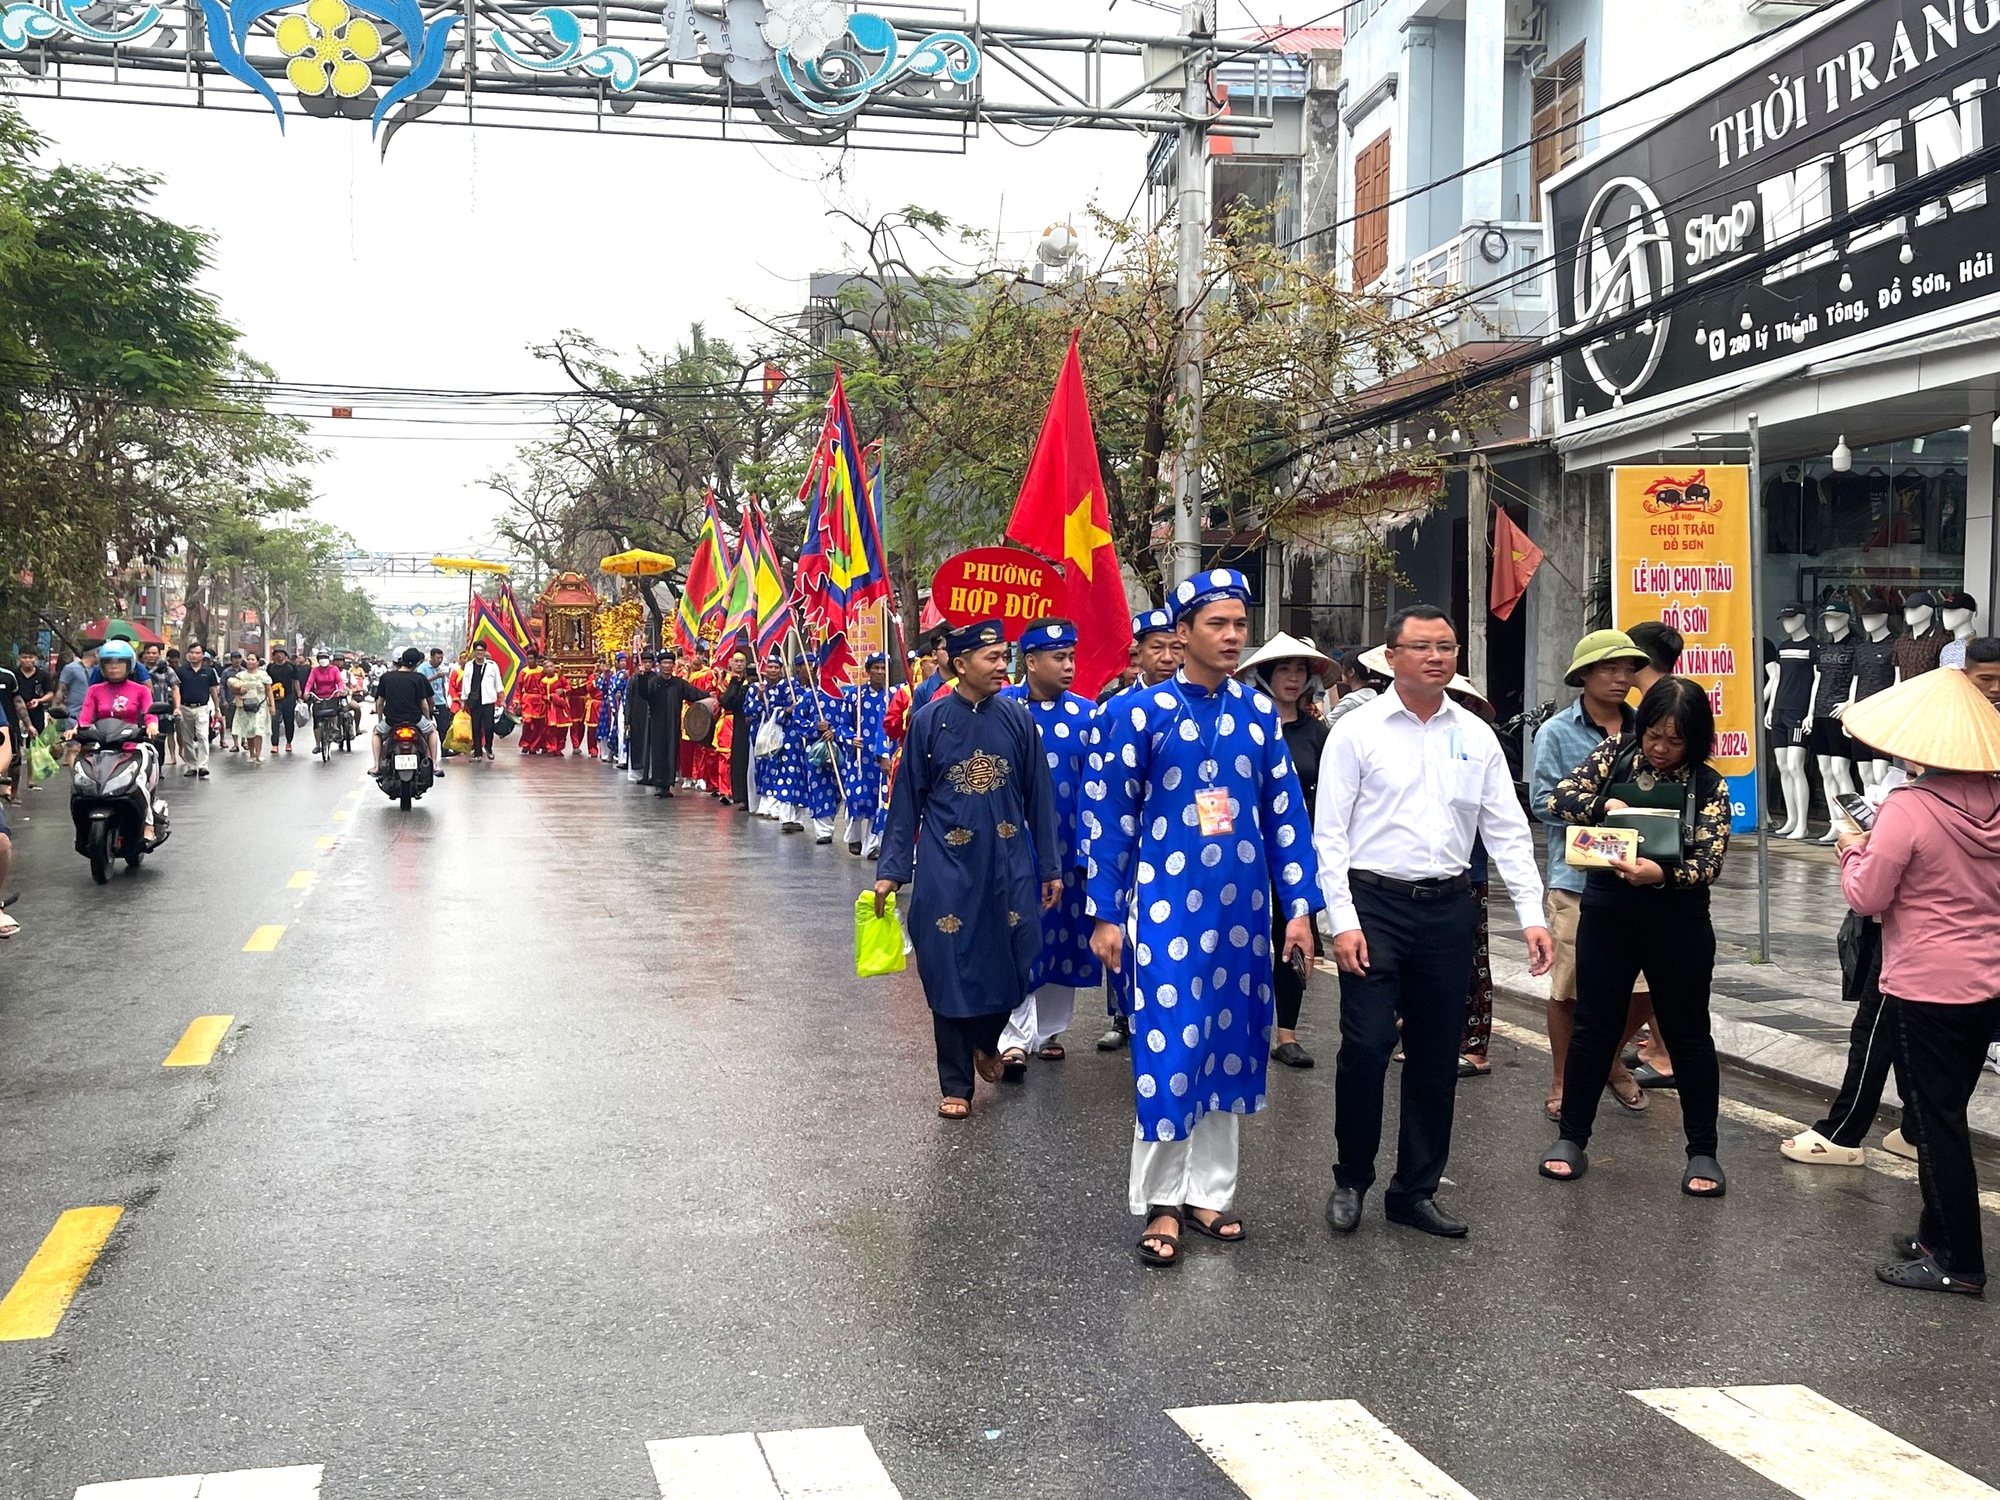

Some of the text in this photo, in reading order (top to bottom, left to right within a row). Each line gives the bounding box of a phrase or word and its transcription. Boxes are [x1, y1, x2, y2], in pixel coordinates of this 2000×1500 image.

[1709, 0, 2000, 169] THỜI TRANG
[1685, 200, 1756, 266] Shop
[1729, 334, 1751, 357] 280
[1755, 324, 1769, 350] Lý
[1825, 300, 1869, 326] Tông,
[1878, 277, 1902, 310] Đồ
[1911, 272, 1951, 297] Sơn,
[1959, 252, 1994, 284] Hải
[1650, 521, 1715, 538] CHỌI TRÂU
[1682, 539, 1704, 550] SƠN
[962, 561, 1043, 588] PHƯỜNG
[1633, 559, 1732, 597] LỄ HỘI CHỌI TRÂU
[949, 586, 1053, 620] HỢP ĐỨC
[1683, 606, 1707, 633] SƠN
[1686, 645, 1709, 674] VĂN
[1711, 644, 1734, 674] HÓA
[1721, 732, 1748, 756] 2024
